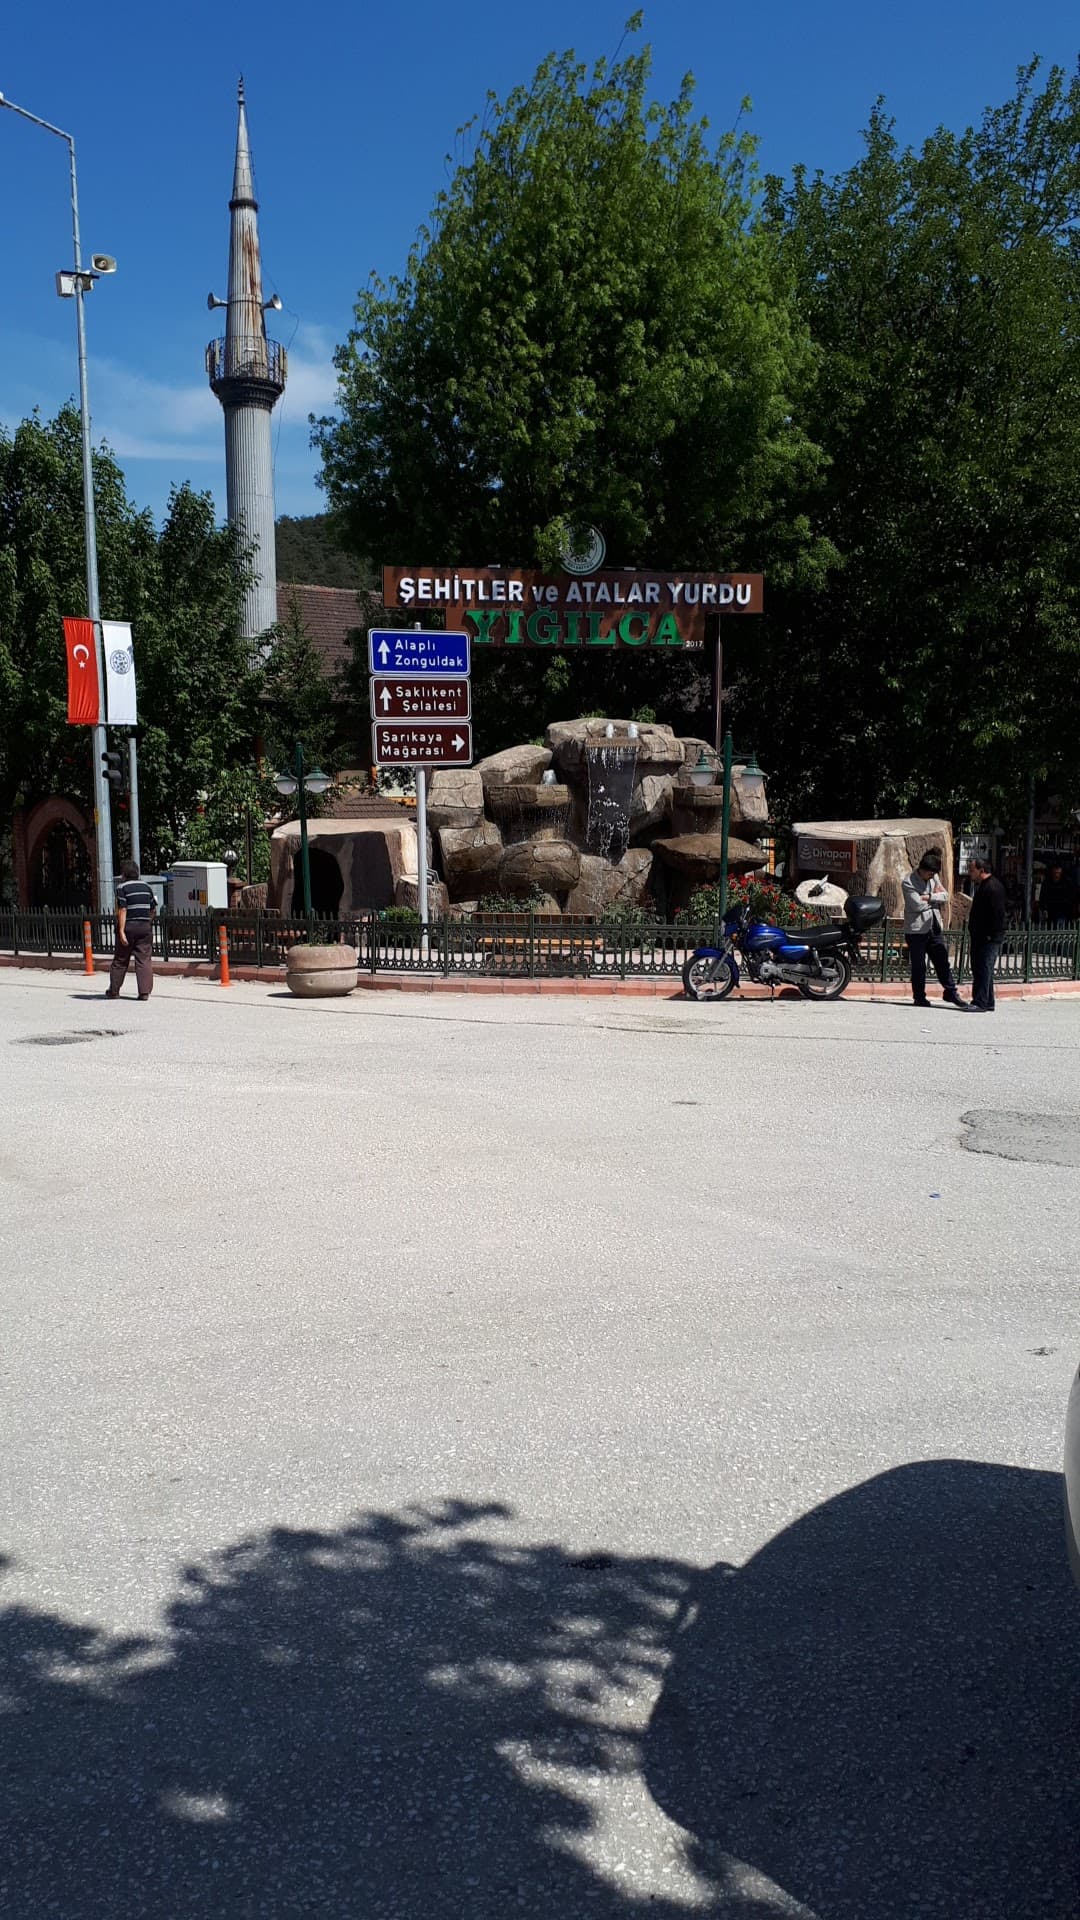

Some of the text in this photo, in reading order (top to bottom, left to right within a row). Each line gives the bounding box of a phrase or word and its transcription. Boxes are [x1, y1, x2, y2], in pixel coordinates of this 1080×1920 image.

[399, 574, 752, 605] ŞEHİTLER ve ATALAR YURDU
[465, 604, 684, 646] YIĞILCA
[395, 639, 435, 653] Alaplı
[685, 640, 703, 648] 2017
[395, 655, 463, 669] Zonguldak
[396, 686, 462, 698] Saklıkent
[402, 700, 457, 713] Şelalesi
[382, 731, 443, 745] Sarıkaya
[381, 745, 444, 758] Mağarası
[812, 847, 852, 861] Divapan
